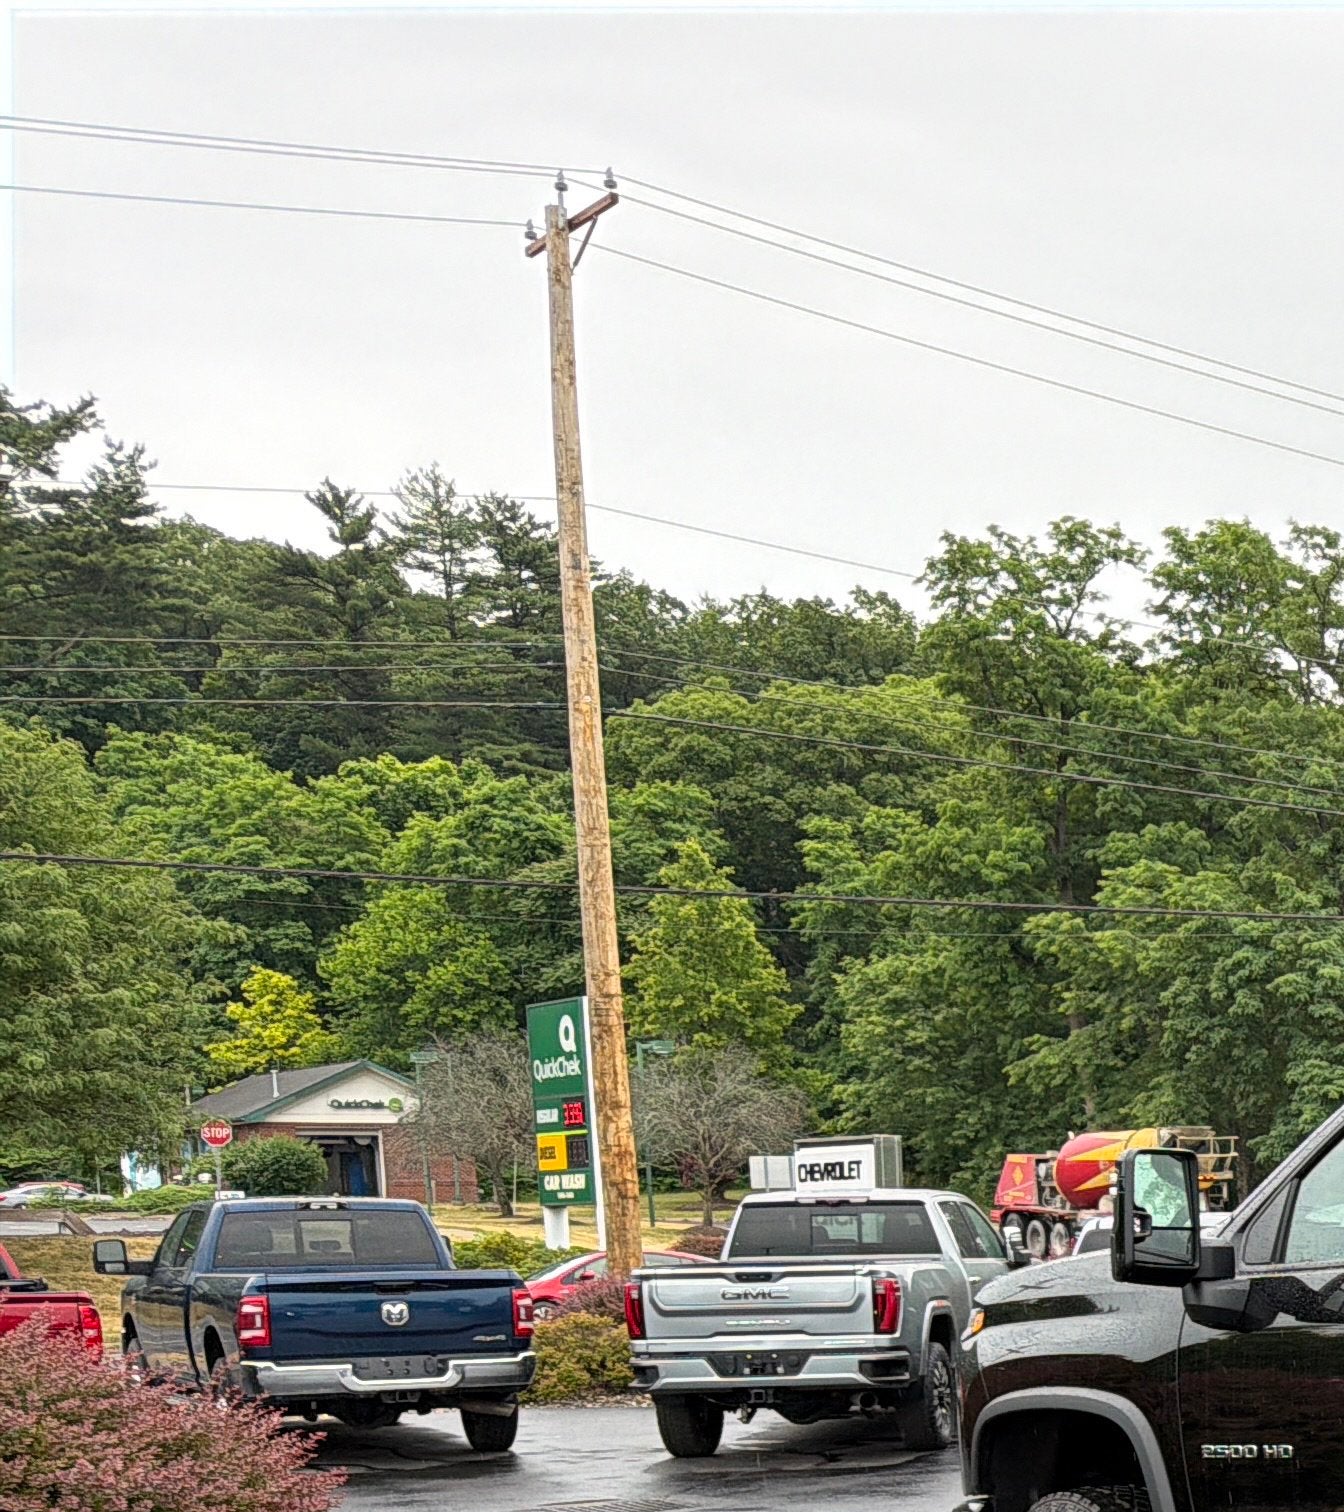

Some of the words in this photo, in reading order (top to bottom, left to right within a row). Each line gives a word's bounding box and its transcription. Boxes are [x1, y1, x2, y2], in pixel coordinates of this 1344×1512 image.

[533, 1053, 581, 1083] QuickChek
[203, 1127, 229, 1138] STOP
[798, 1160, 862, 1182] CHEVROLET
[720, 1286, 790, 1300] GMC
[1201, 1445, 1257, 1458] 2500
[1263, 1445, 1294, 1458] HD
